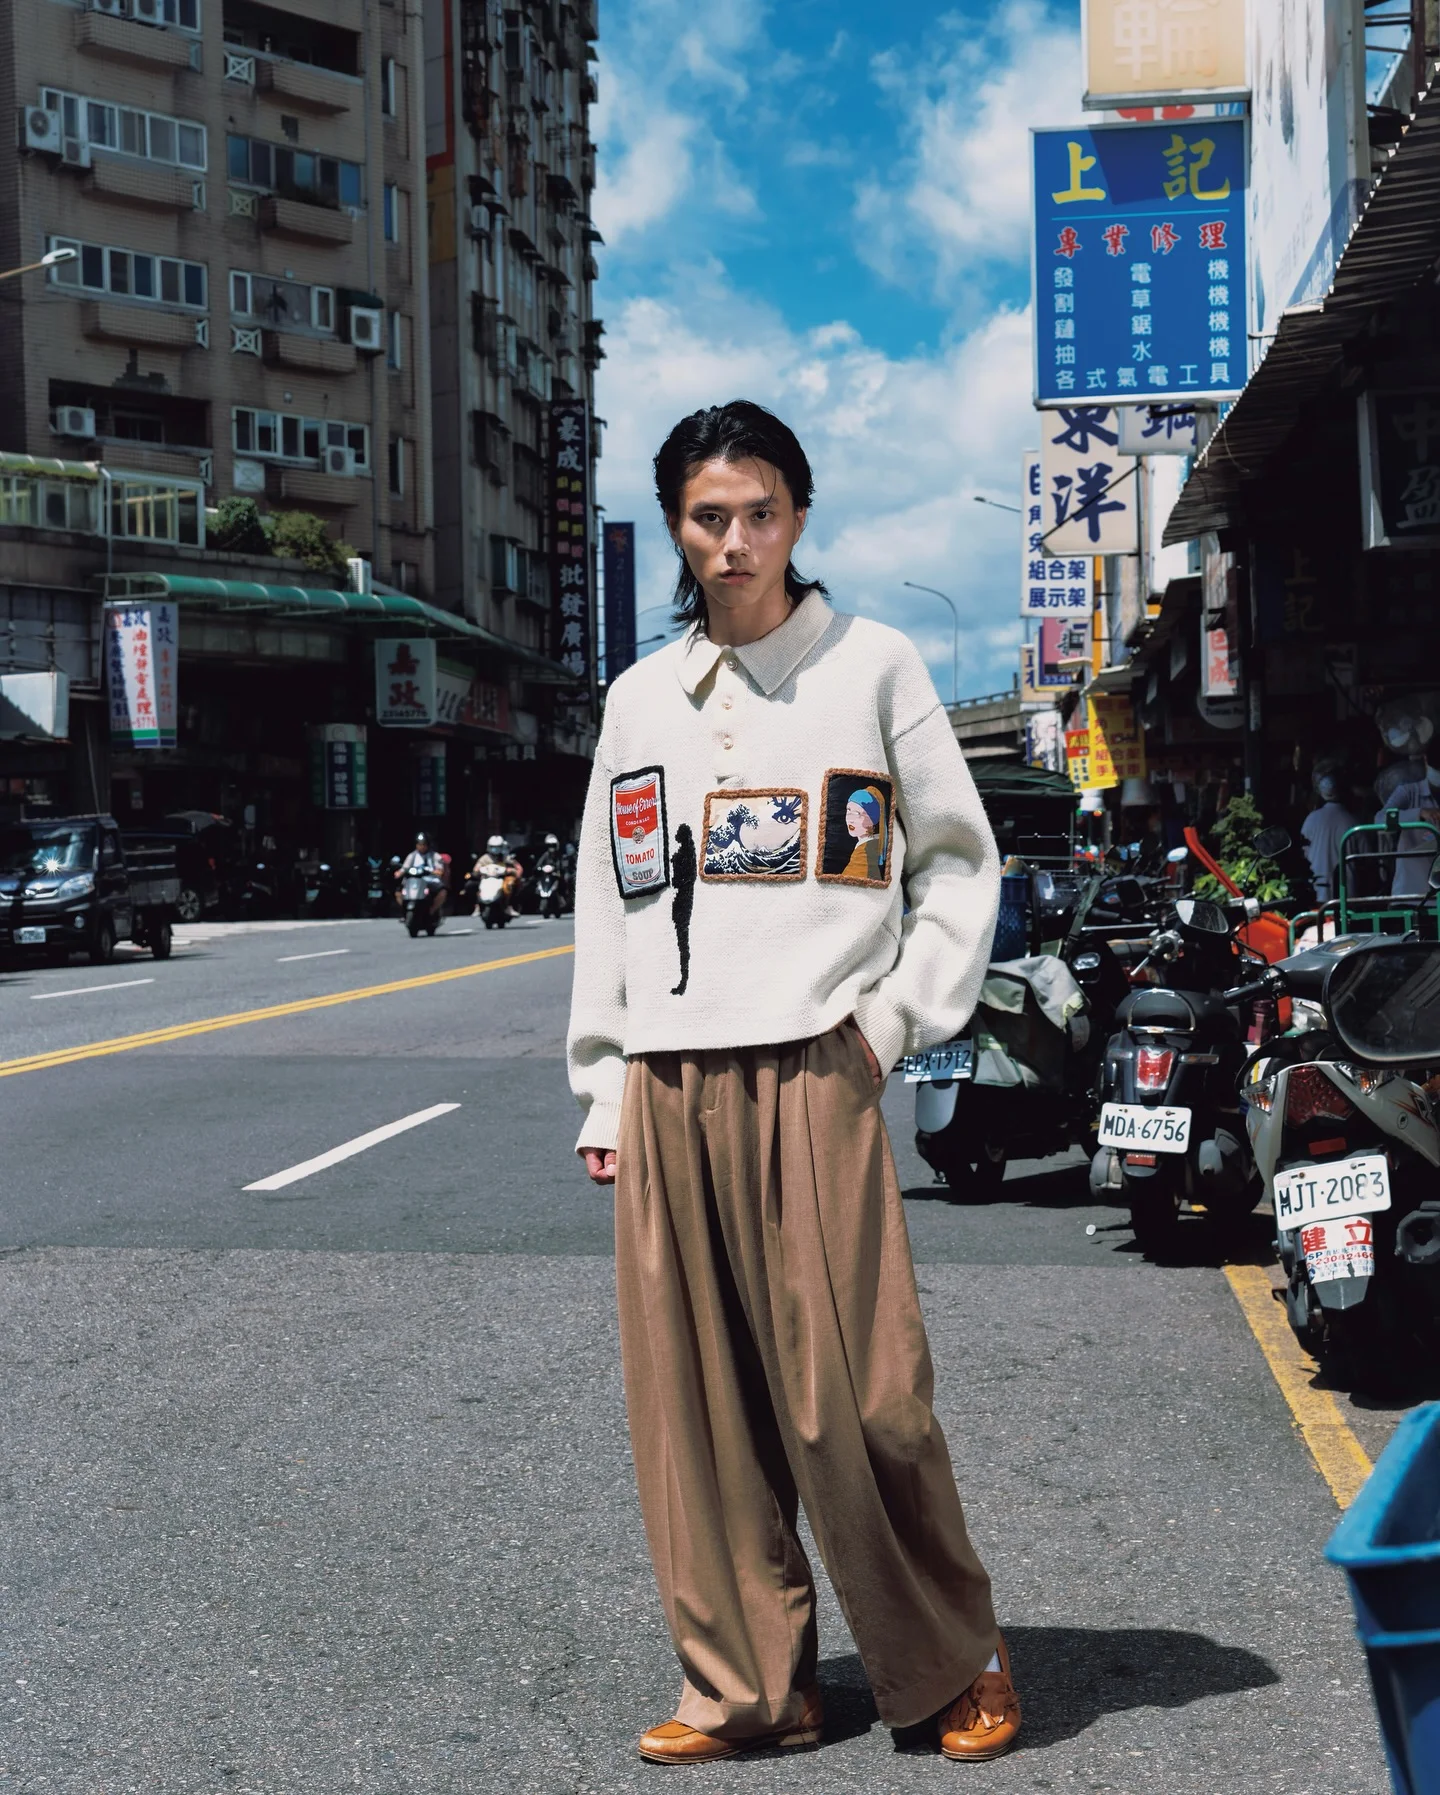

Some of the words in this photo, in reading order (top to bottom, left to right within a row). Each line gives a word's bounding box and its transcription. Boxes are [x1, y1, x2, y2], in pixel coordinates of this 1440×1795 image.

[1052, 134, 1230, 204] 上記
[1054, 220, 1227, 259] 專業修理
[1056, 362, 1230, 390] 各式氣電工具
[1028, 560, 1086, 580] 組合架
[1028, 587, 1086, 608] 展示架
[626, 848, 654, 864] TOMATO
[632, 868, 653, 880] SOUP
[1301, 1219, 1373, 1255] 建立
